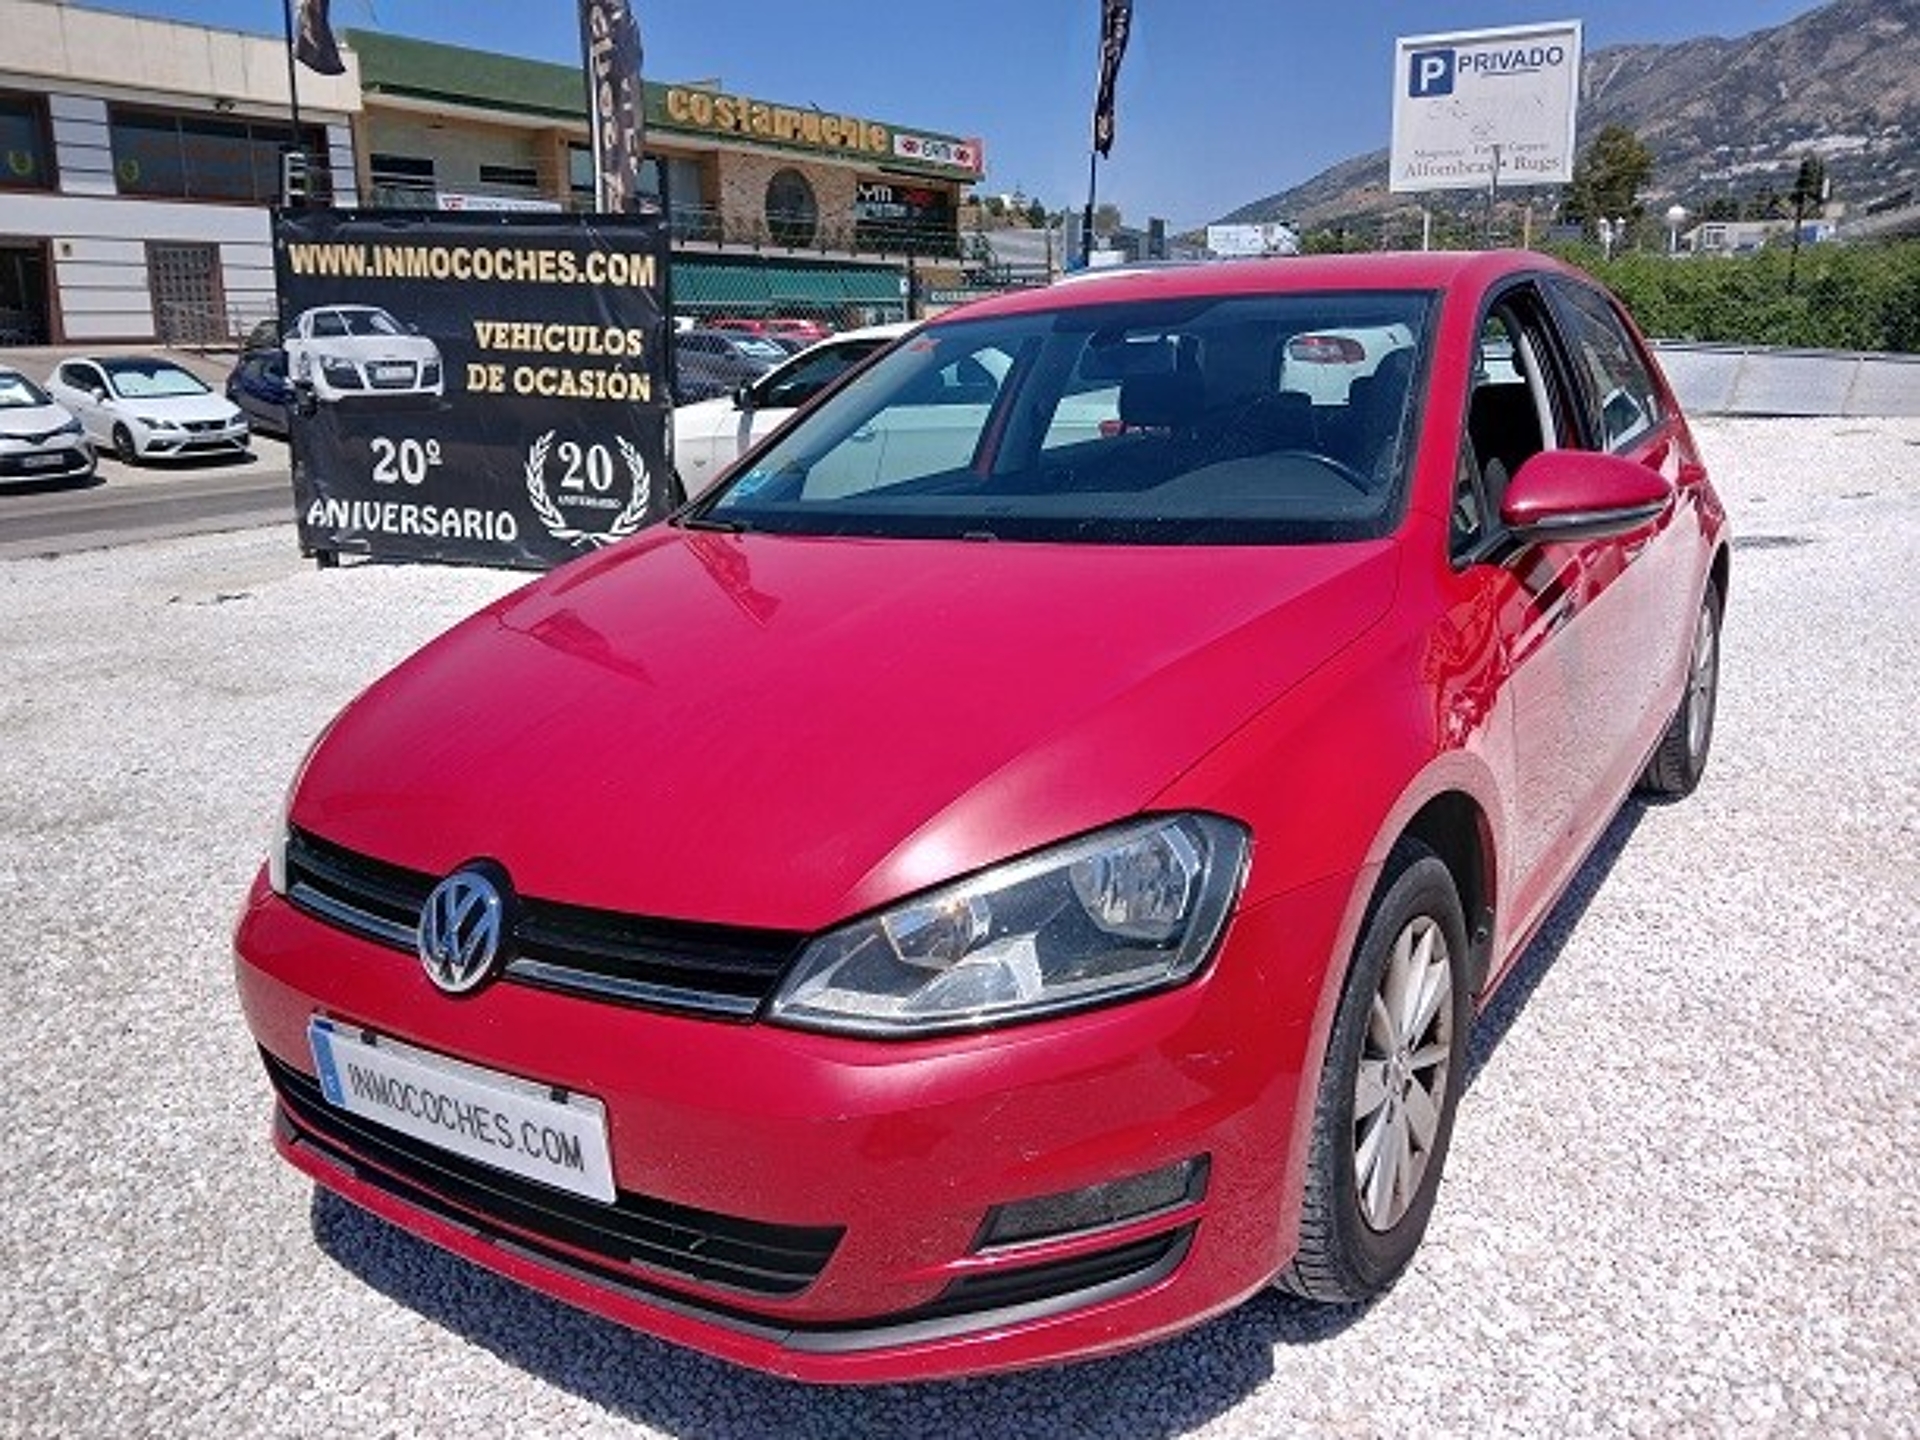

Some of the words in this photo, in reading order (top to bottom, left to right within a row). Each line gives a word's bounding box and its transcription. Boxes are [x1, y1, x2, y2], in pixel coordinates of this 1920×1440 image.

[1420, 57, 1446, 92] P
[1458, 46, 1564, 73] PRIVADO
[1405, 159, 1494, 178] Alfombras
[1514, 155, 1560, 173] Rugs
[288, 243, 656, 287] WWW.INMOCOCHES.COM
[473, 320, 644, 357] VEHICULOS
[467, 364, 506, 393] DE
[513, 364, 651, 402] OCASIÓN
[370, 436, 443, 486] 20º
[557, 441, 614, 491] 20
[306, 498, 518, 541] ANIVERSARIO
[347, 1062, 586, 1172] INMOCOCHES.COM
